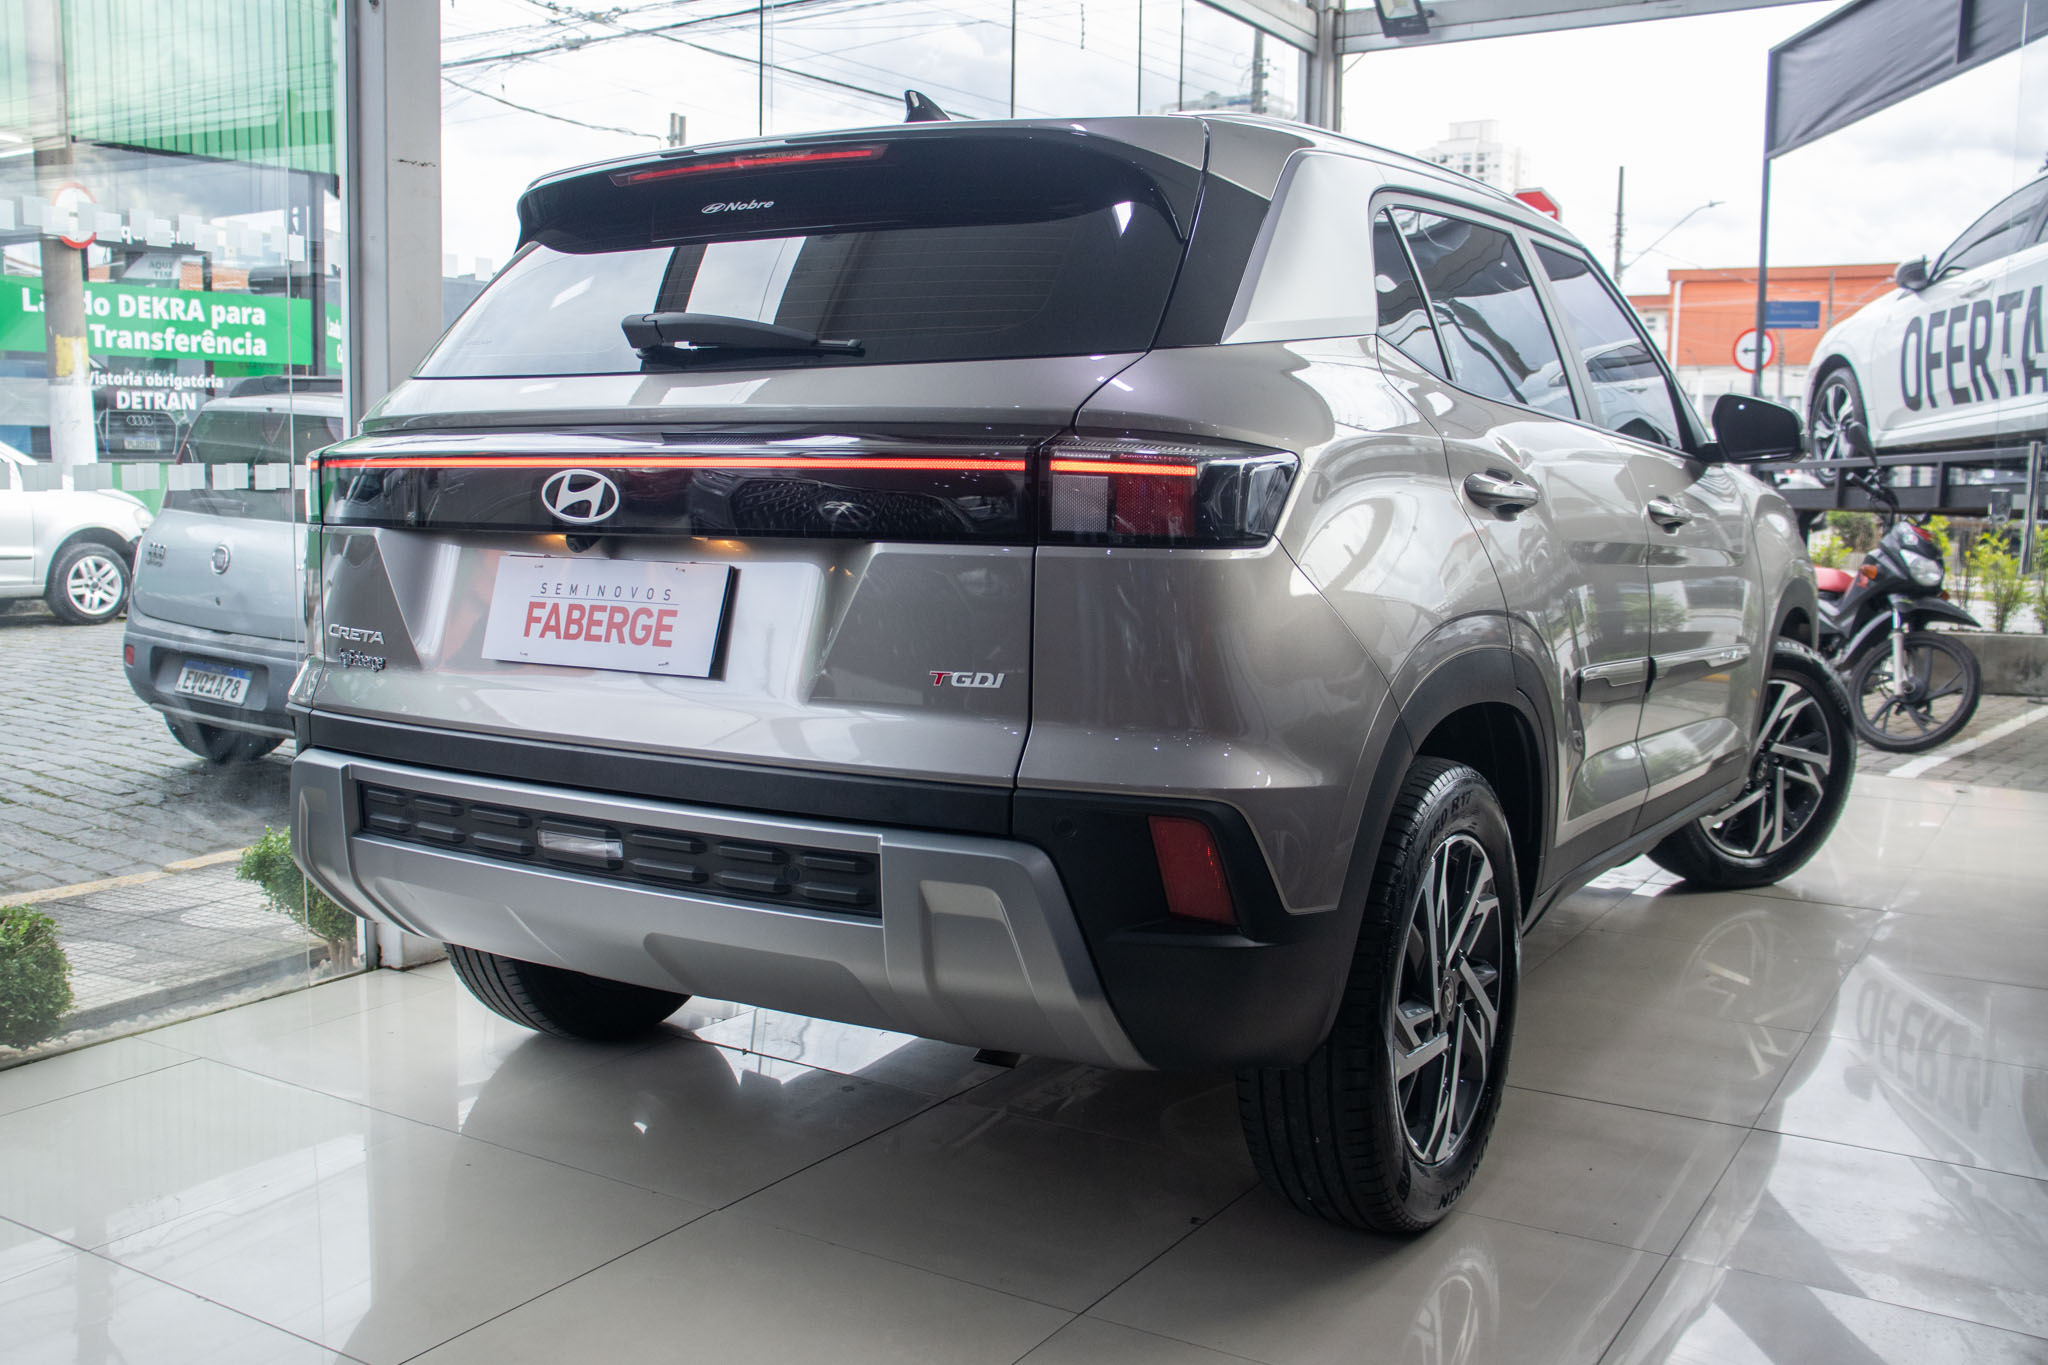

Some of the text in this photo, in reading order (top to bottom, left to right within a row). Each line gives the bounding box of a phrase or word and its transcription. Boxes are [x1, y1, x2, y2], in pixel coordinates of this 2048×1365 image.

[723, 199, 775, 212] Nobre
[22, 287, 266, 330] Ldo DEKRA para
[88, 323, 267, 356] Transferência
[1900, 285, 2048, 412] OFERTA
[145, 372, 224, 391] obrigatória
[116, 389, 197, 411] DETRAN
[540, 582, 672, 601] SEMINOVOS
[328, 623, 385, 645] CRETA
[523, 601, 678, 648] FABERGE
[929, 670, 1005, 689] TGDI
